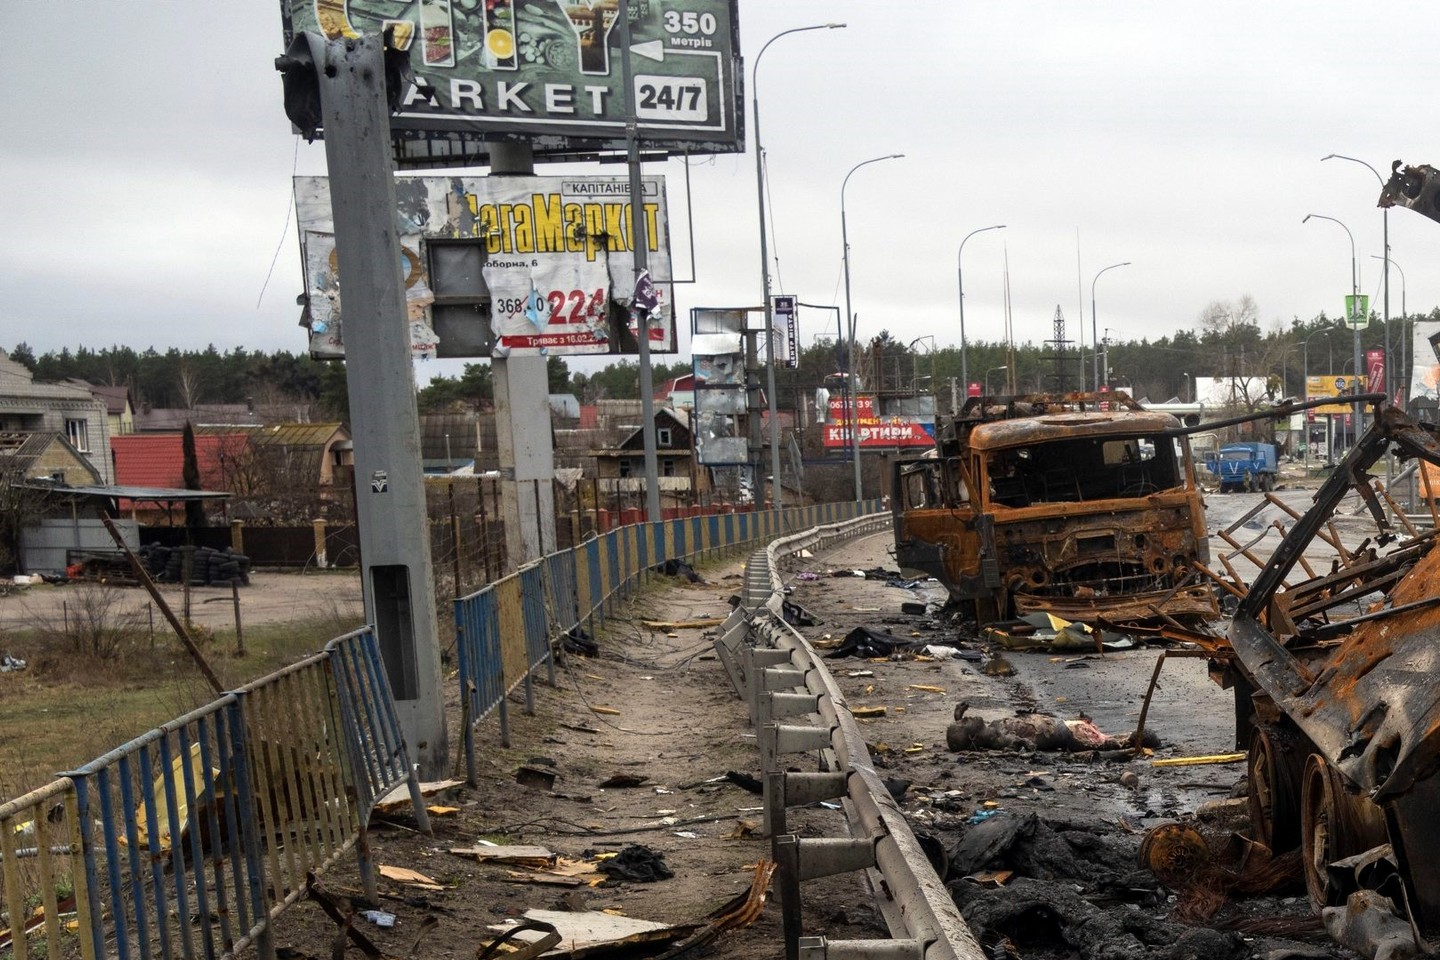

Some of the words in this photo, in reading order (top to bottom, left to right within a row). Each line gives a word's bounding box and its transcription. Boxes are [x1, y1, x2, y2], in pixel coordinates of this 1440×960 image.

[663, 10, 717, 35] 350
[671, 37, 712, 48] метрів
[402, 76, 609, 115] ARKET
[639, 84, 702, 111] 24/7
[572, 183, 648, 194] КАПІТАНІА
[446, 193, 660, 262] егаМаркт
[482, 259, 529, 269] оборна,
[531, 259, 539, 268] 6
[497, 296, 545, 316] 368,0
[829, 427, 913, 441] КВРТИРИ
[1228, 461, 1239, 475] V
